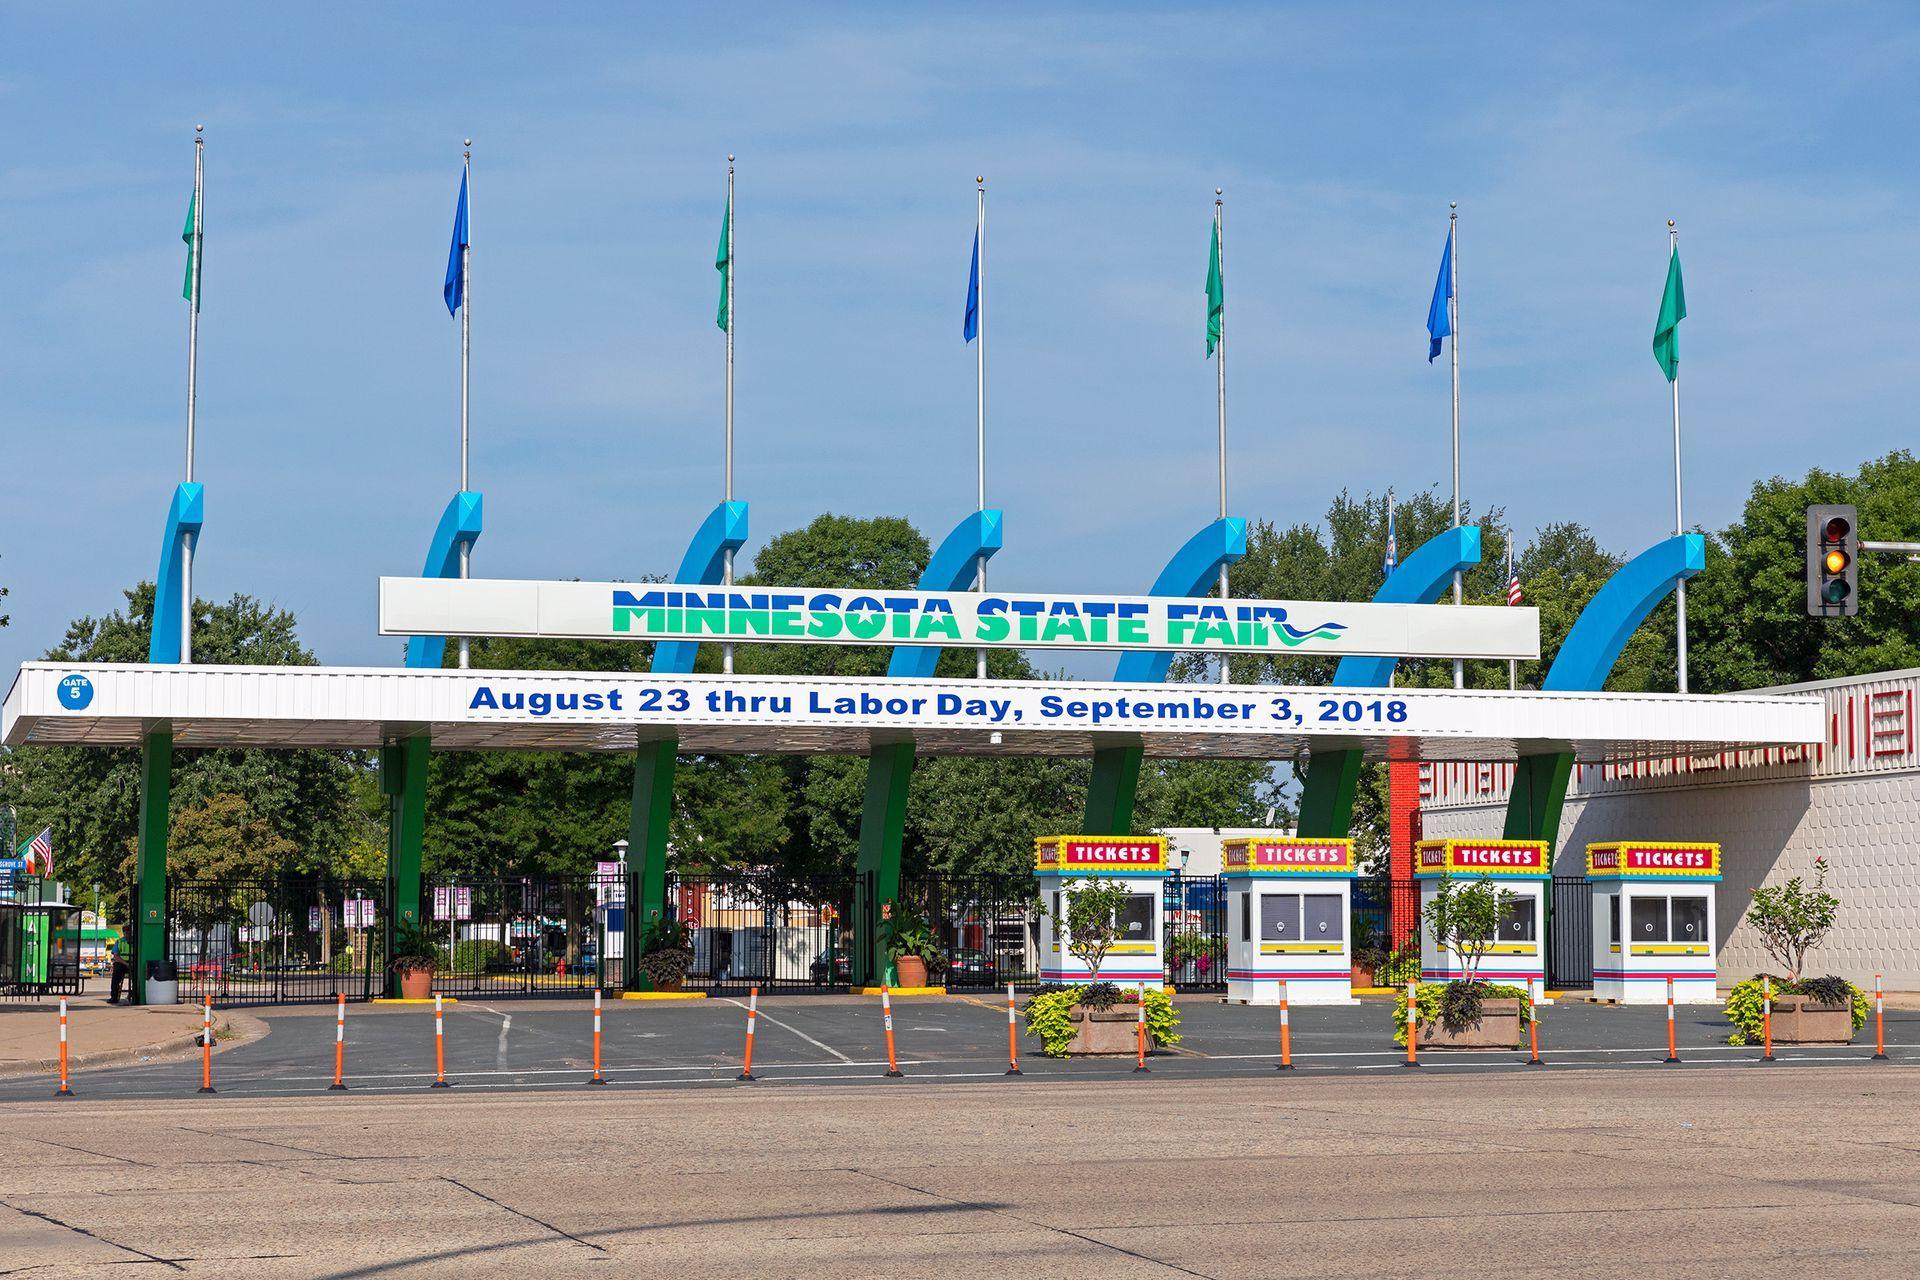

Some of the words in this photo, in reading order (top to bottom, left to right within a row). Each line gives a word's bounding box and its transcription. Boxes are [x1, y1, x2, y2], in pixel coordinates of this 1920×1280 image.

[613, 590, 962, 639] MINNESOTA
[975, 597, 1149, 643] STATE
[1167, 604, 1306, 646] FAIR
[62, 679, 88, 687] GATE
[70, 687, 81, 699] 5
[470, 687, 623, 716] August
[639, 689, 690, 712] 23
[705, 690, 792, 714] thru
[809, 692, 927, 715] Labor
[937, 694, 1023, 722] Day,
[1040, 696, 1256, 724] September
[1271, 699, 1303, 725] 3,
[1319, 701, 1408, 723] 2018
[1075, 847, 1151, 861] TICKETS
[1265, 848, 1339, 862] TICKETS
[1461, 850, 1533, 864] TICKETS
[1594, 852, 1618, 866] TICKETS
[1635, 852, 1705, 866] TICKETS
